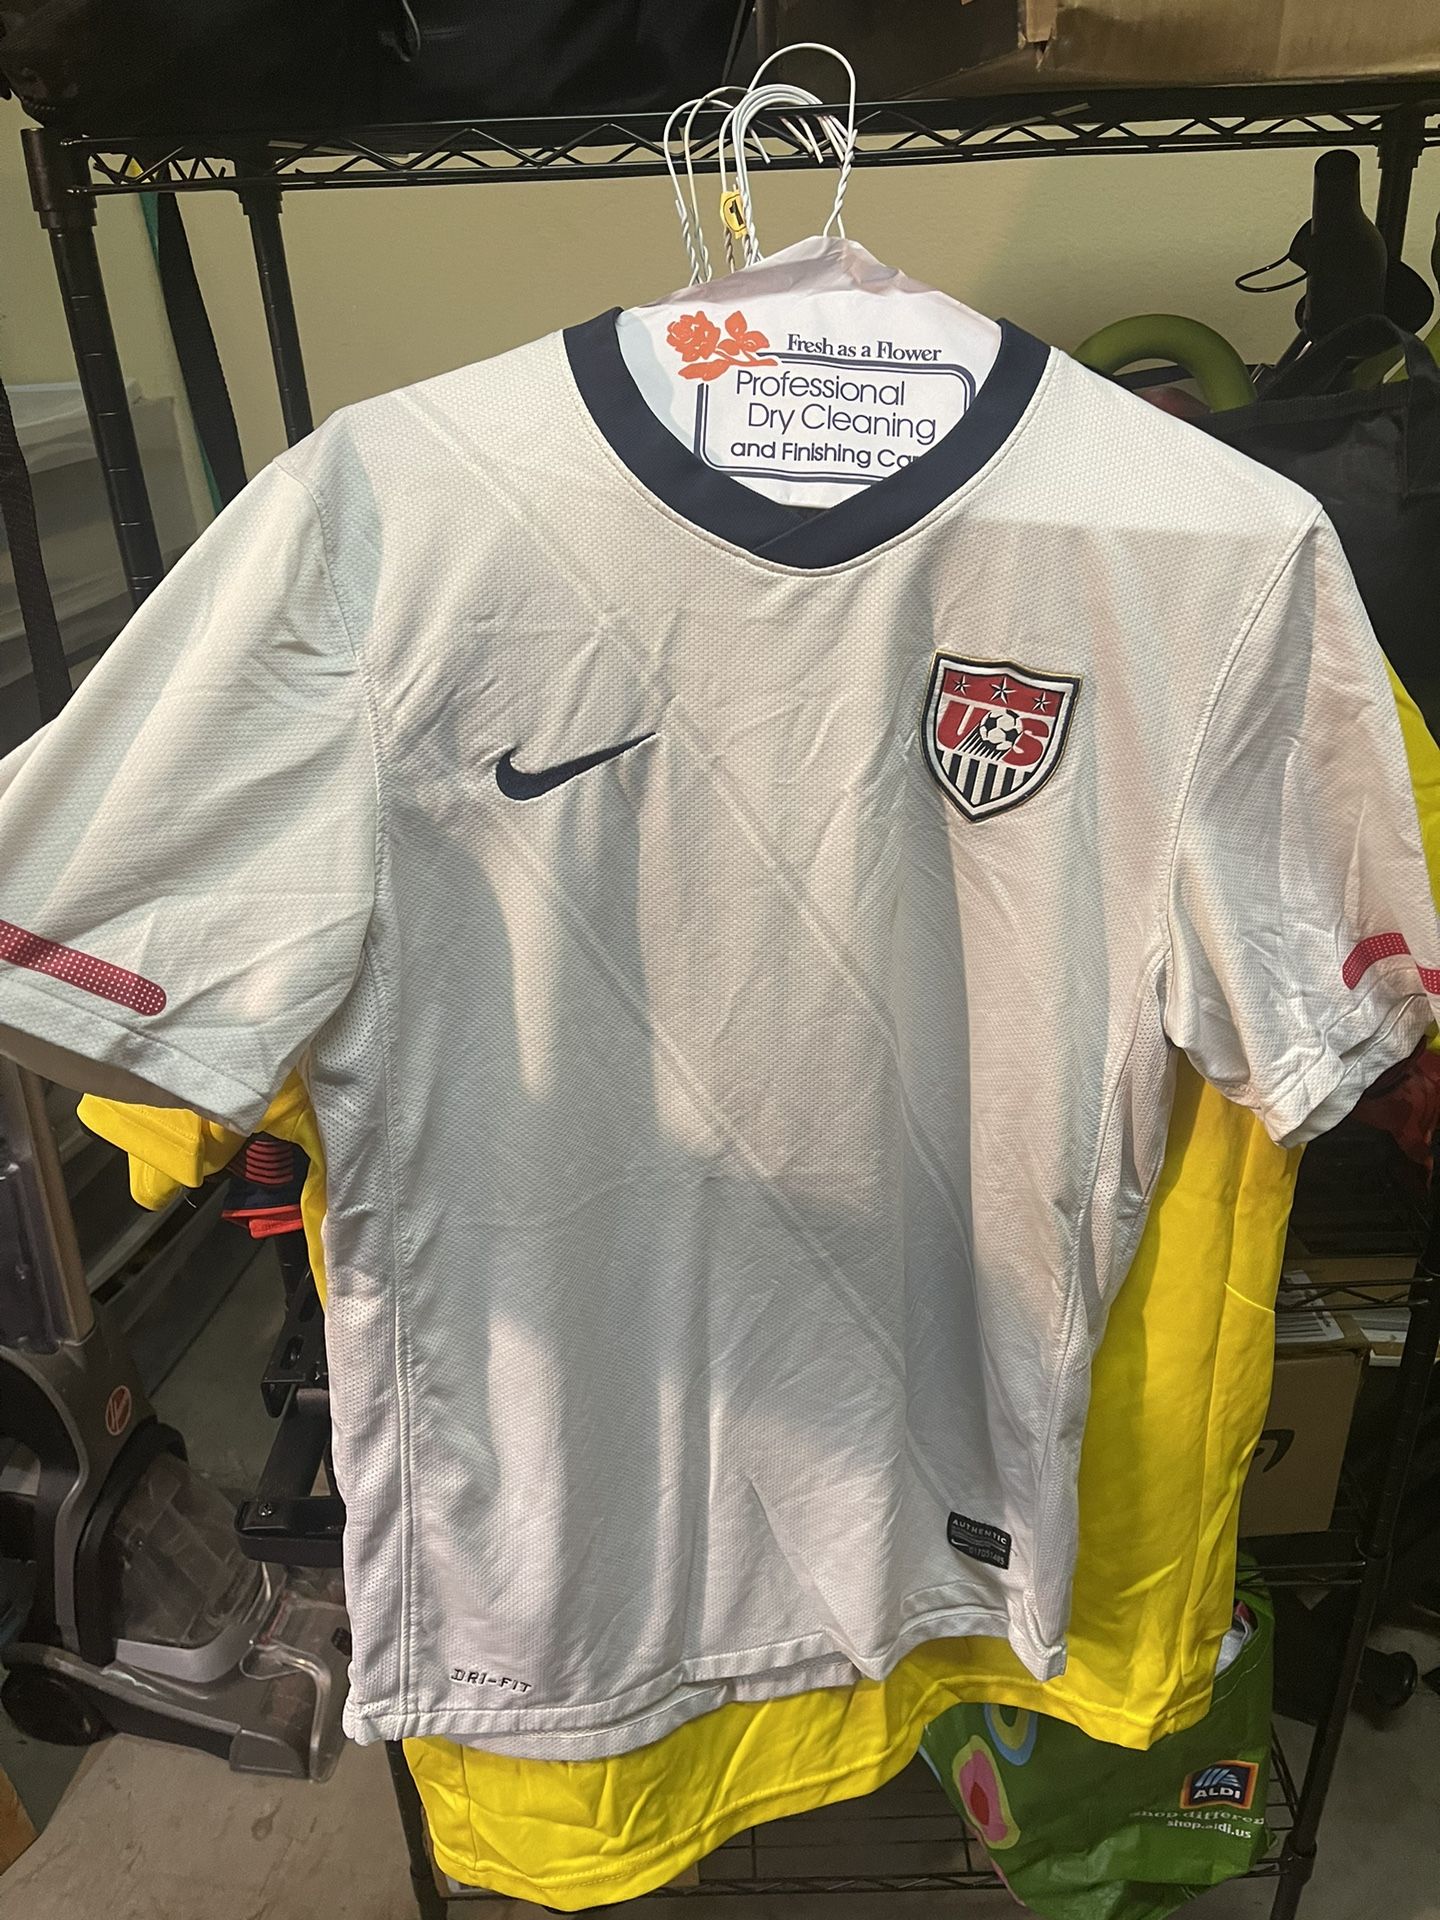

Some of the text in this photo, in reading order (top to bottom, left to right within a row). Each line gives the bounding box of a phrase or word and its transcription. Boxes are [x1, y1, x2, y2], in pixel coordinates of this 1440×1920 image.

[729, 200, 744, 226] 1
[787, 333, 942, 361] Fresh as a Flower
[736, 370, 906, 406] Professional
[748, 402, 937, 446] Dry Cleaning
[730, 441, 921, 469] and Finishing Ca
[937, 700, 1050, 767] US
[952, 1519, 1007, 1545] AUTHENTIC
[451, 1668, 532, 1693] DRI-FIT
[1193, 1787, 1241, 1799] ALDI
[1167, 1820, 1251, 1838] shop.aldi.us
